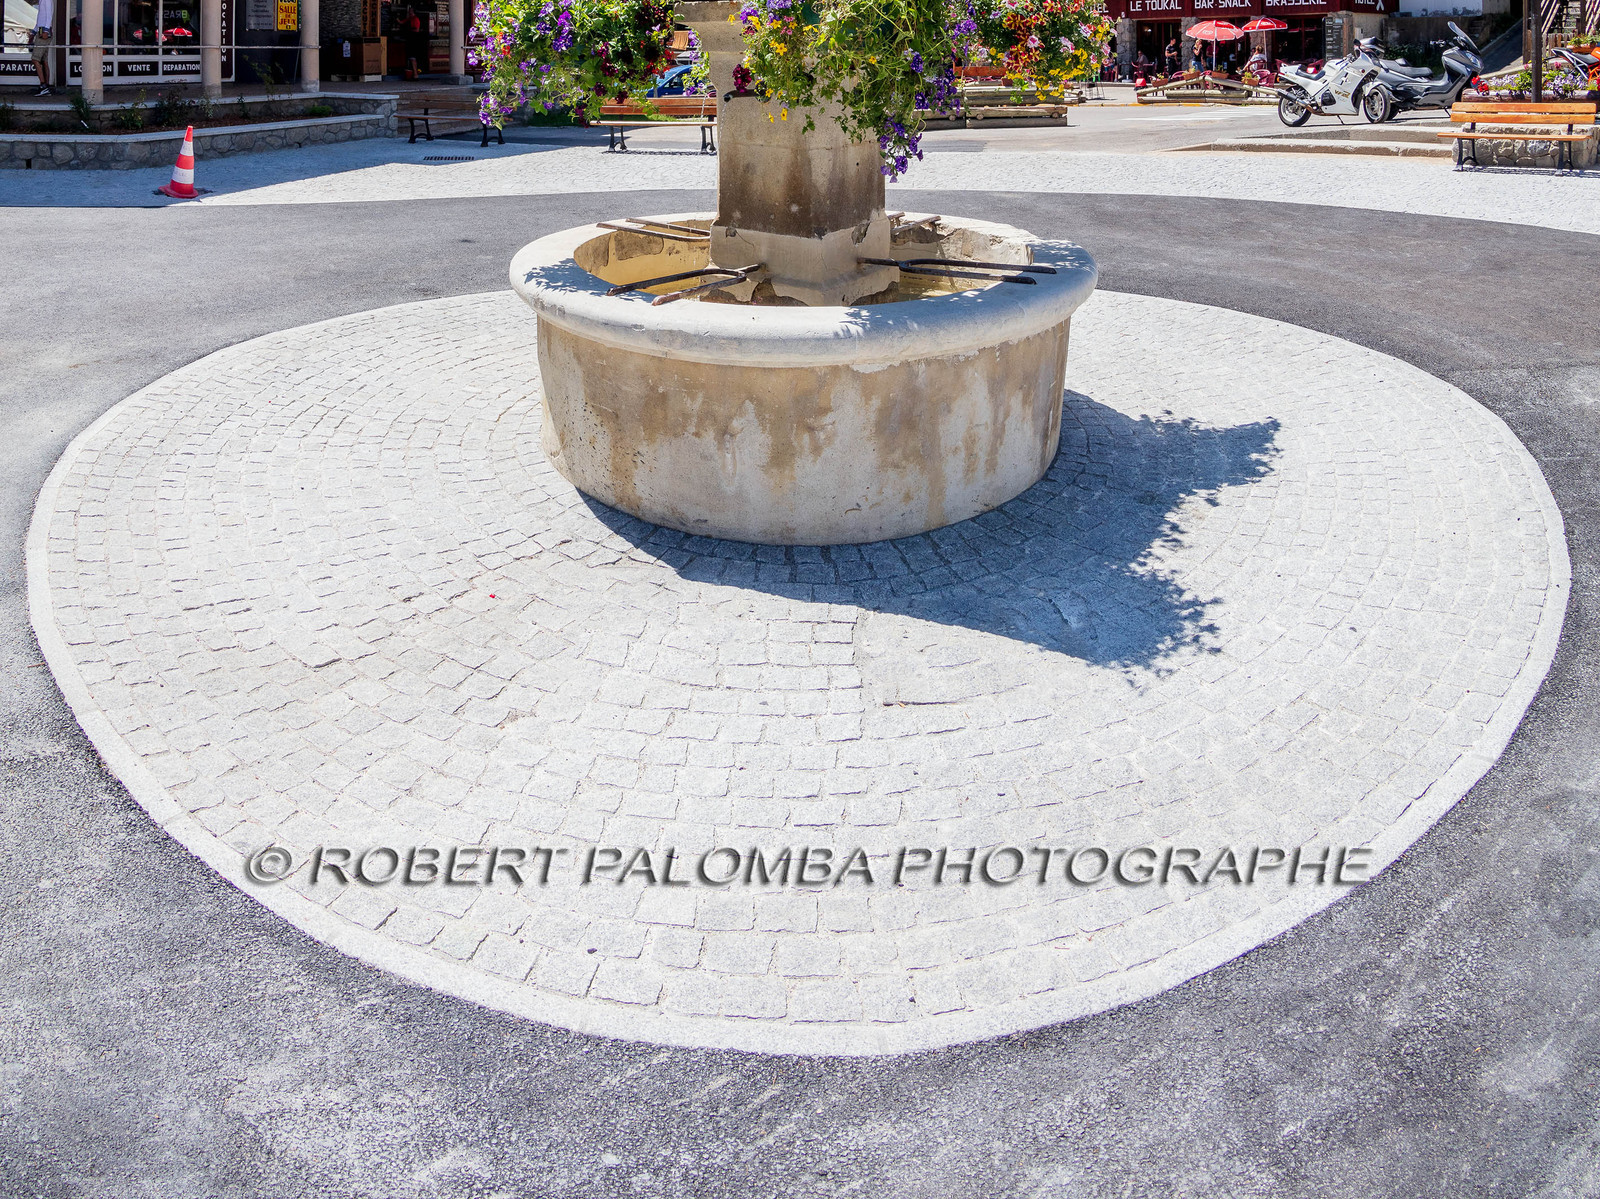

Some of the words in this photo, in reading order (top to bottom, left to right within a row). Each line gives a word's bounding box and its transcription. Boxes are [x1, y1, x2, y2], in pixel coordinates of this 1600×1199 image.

[279, 5, 296, 14] SALLE
[1130, 1, 1142, 11] LE
[1145, 0, 1182, 11] TOUKAL
